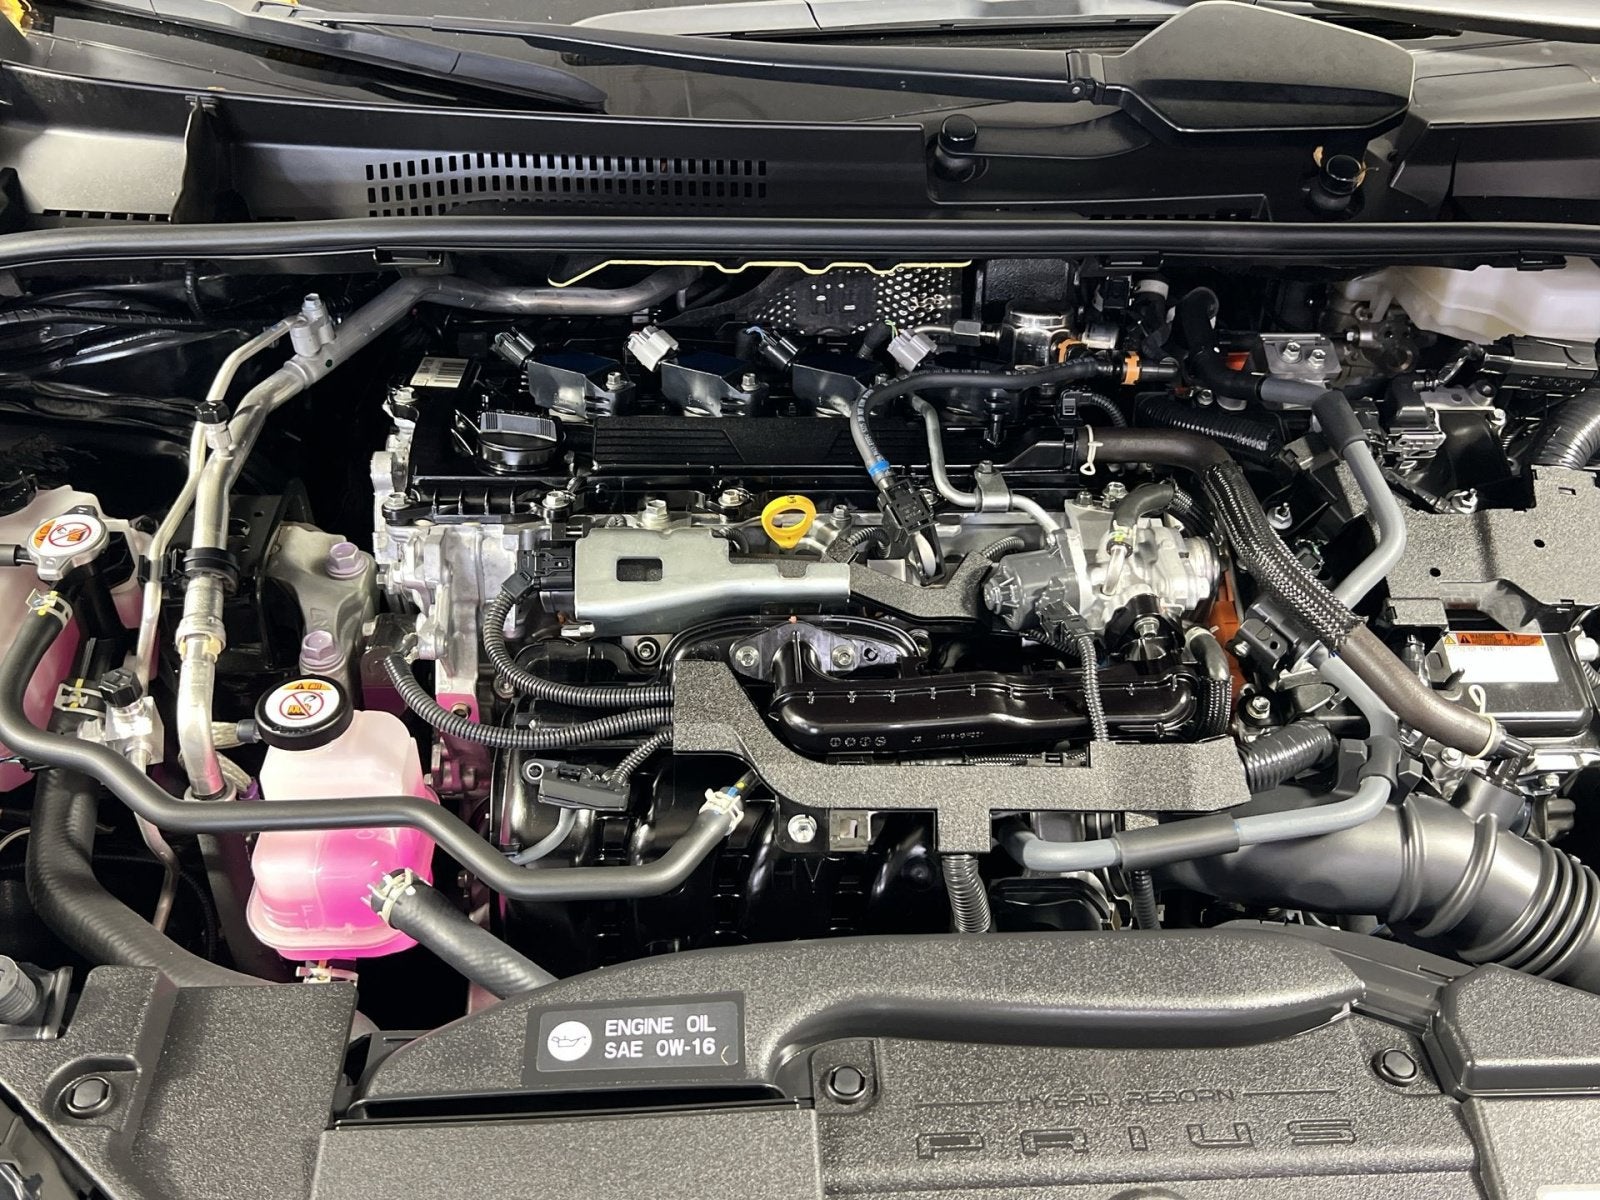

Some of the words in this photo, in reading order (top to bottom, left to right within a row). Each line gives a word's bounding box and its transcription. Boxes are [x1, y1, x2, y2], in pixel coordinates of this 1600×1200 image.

[605, 1016, 674, 1036] ENGINE
[686, 1014, 717, 1032] OIL
[604, 1040, 644, 1059] SAE
[656, 1037, 716, 1057] 0W-16
[1018, 1092, 1110, 1108] HYBRID
[1123, 1088, 1234, 1104] REBORN
[916, 1118, 1356, 1160] PRIUS
